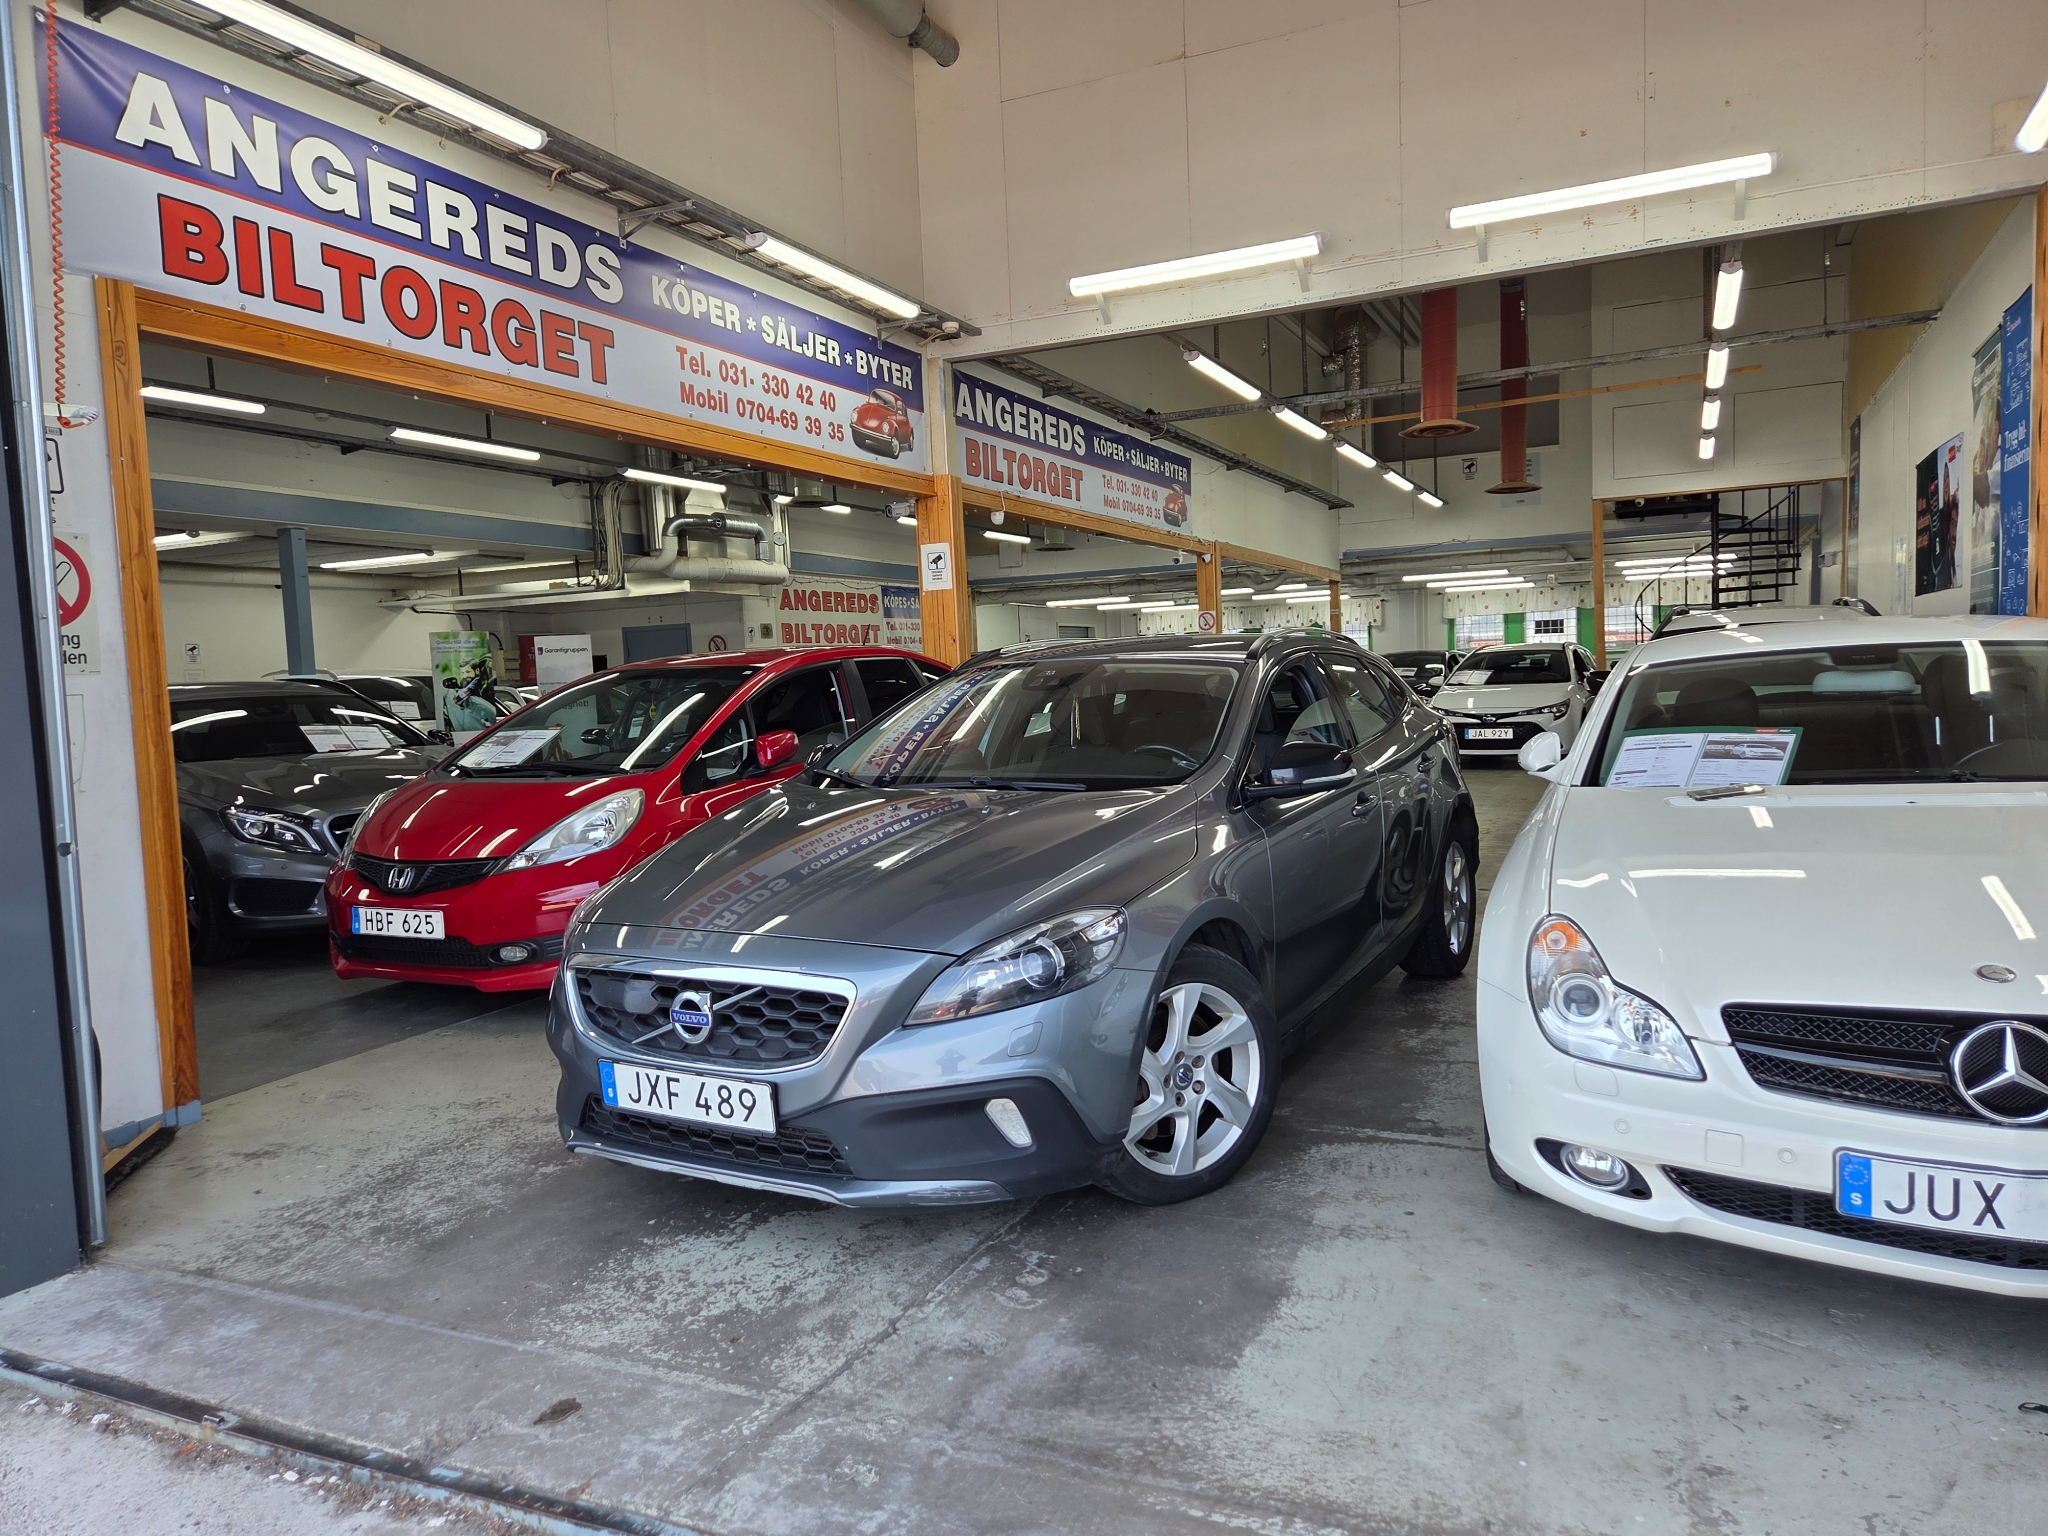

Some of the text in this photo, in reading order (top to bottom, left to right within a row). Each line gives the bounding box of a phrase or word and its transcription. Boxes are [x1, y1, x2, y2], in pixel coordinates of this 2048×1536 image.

[115, 72, 624, 305] ANGEREDS
[157, 193, 615, 385] BILTORGET
[651, 275, 914, 391] KÖPER SÄLJER BYTER
[676, 345, 711, 378] Tel.
[762, 372, 789, 399] 330
[796, 383, 814, 406] 42
[820, 391, 836, 412] 40
[680, 381, 844, 441] Mobil 0704-69 39 35
[956, 382, 1086, 456] ANGEREDS
[965, 437, 1084, 502] BILTORGET
[1093, 434, 1188, 483] KÖPER SÄLJER BYTER
[1102, 474, 1114, 491] Tel.
[1131, 482, 1141, 497] 330
[1143, 486, 1150, 499] 42
[1103, 494, 1121, 510] Mobil
[780, 589, 880, 614] ANGEREDS
[884, 594, 907, 609] KÖPES
[781, 623, 880, 644] BILTORGET
[365, 910, 435, 935] HBF 625
[672, 1012, 707, 1024] VOLVO
[607, 1088, 614, 1097] S
[628, 1071, 757, 1122] JXF 489
[1850, 1192, 1862, 1205] S
[1883, 1171, 2006, 1230] JUX
